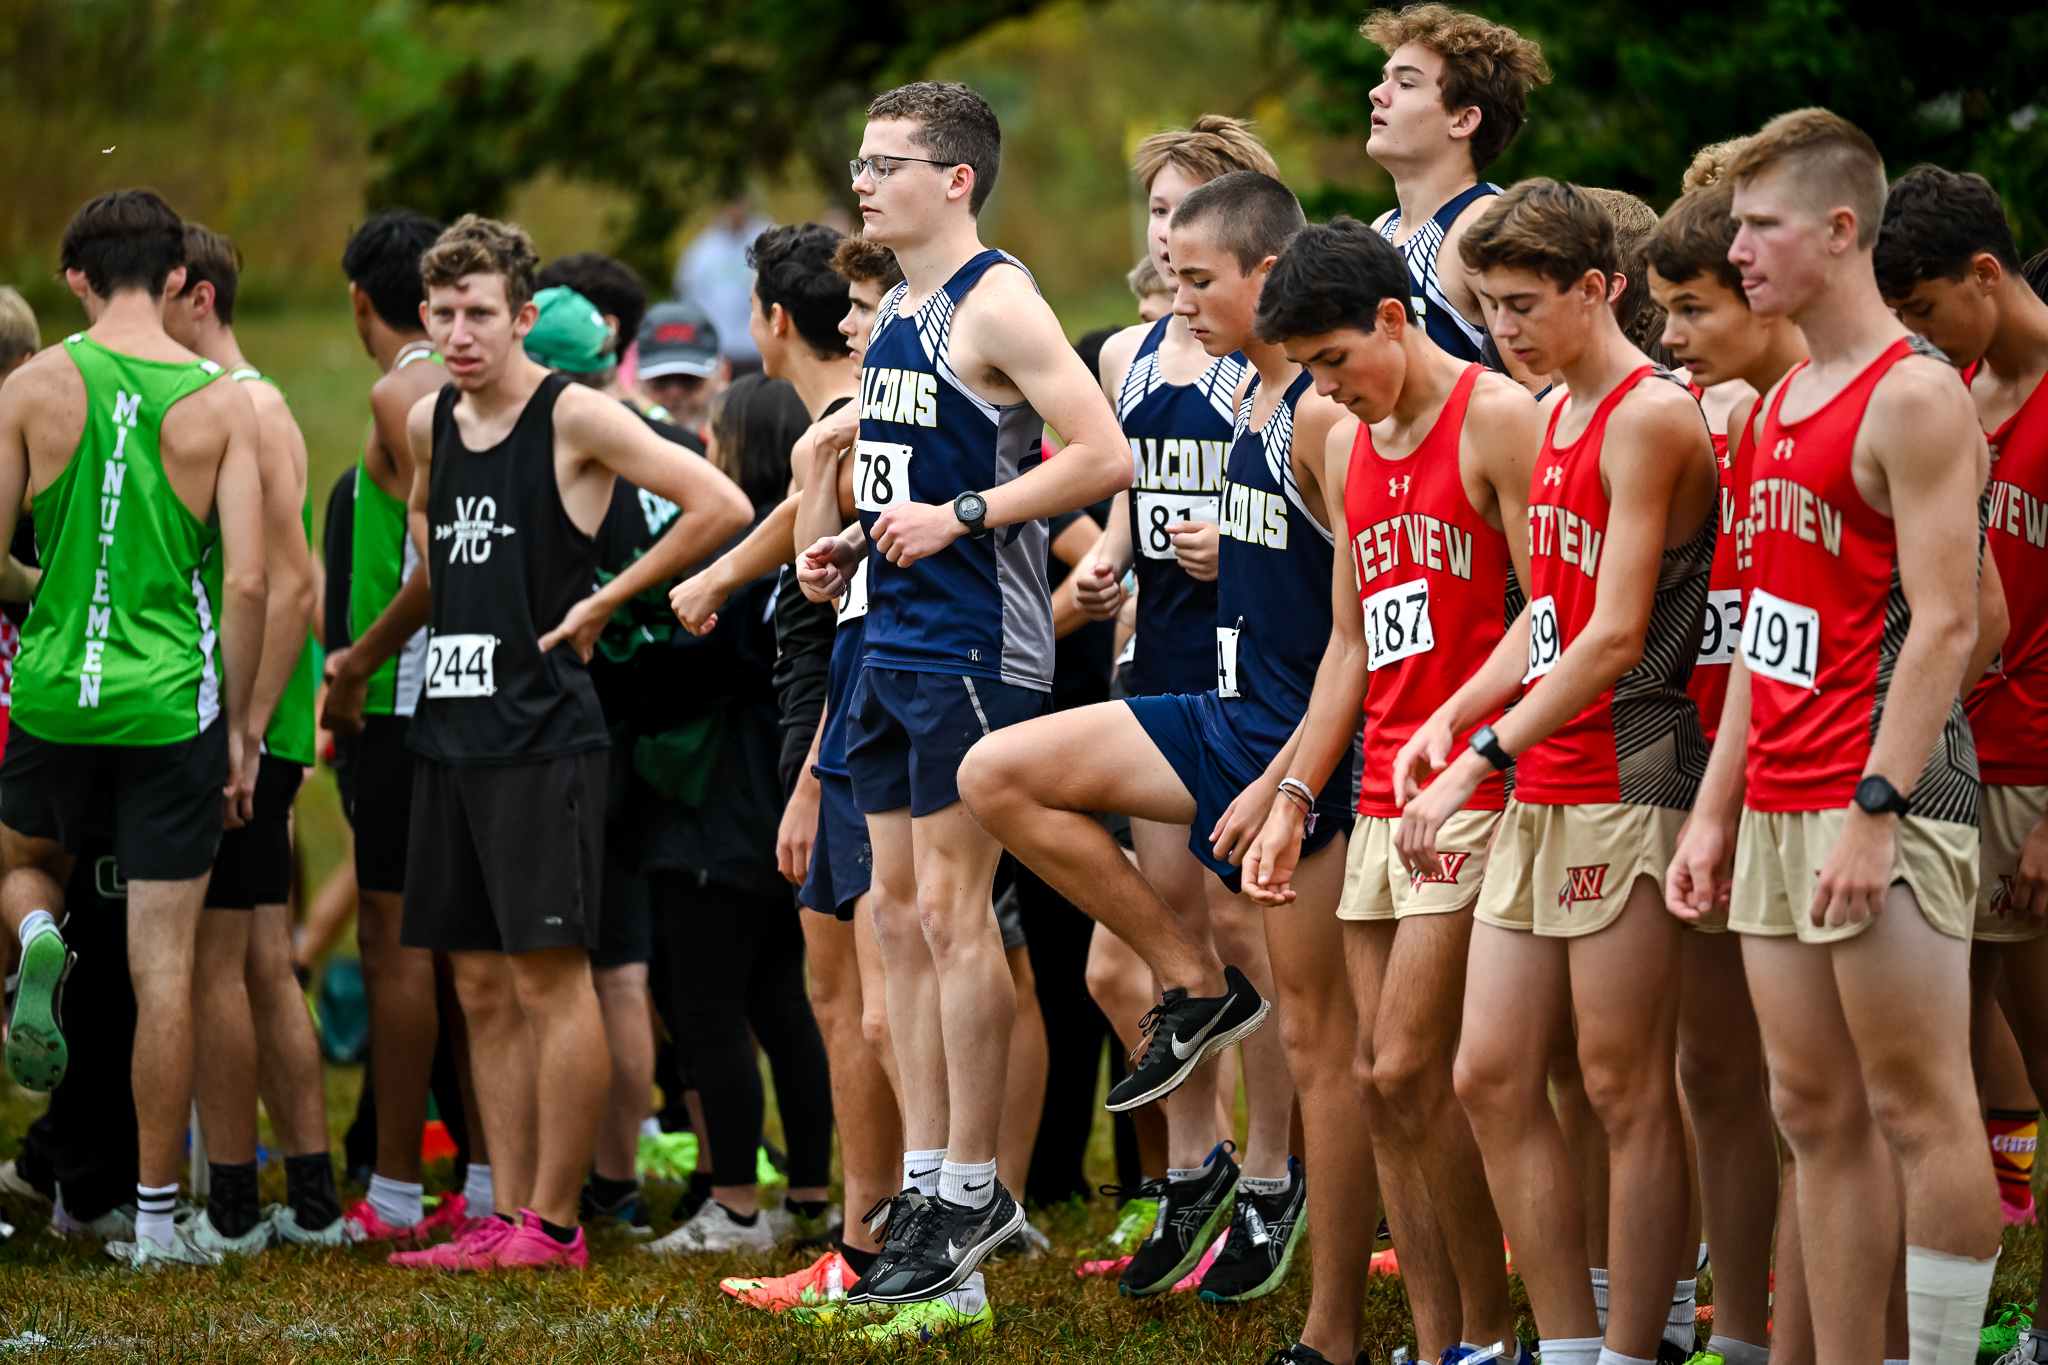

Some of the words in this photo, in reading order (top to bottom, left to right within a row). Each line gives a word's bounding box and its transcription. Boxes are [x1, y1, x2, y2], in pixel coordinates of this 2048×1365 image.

[860, 453, 893, 505] 78
[78, 390, 142, 708] MINUTEMEN
[1371, 592, 1427, 658] 187
[1747, 605, 1812, 680] 191
[429, 645, 488, 688] 244
